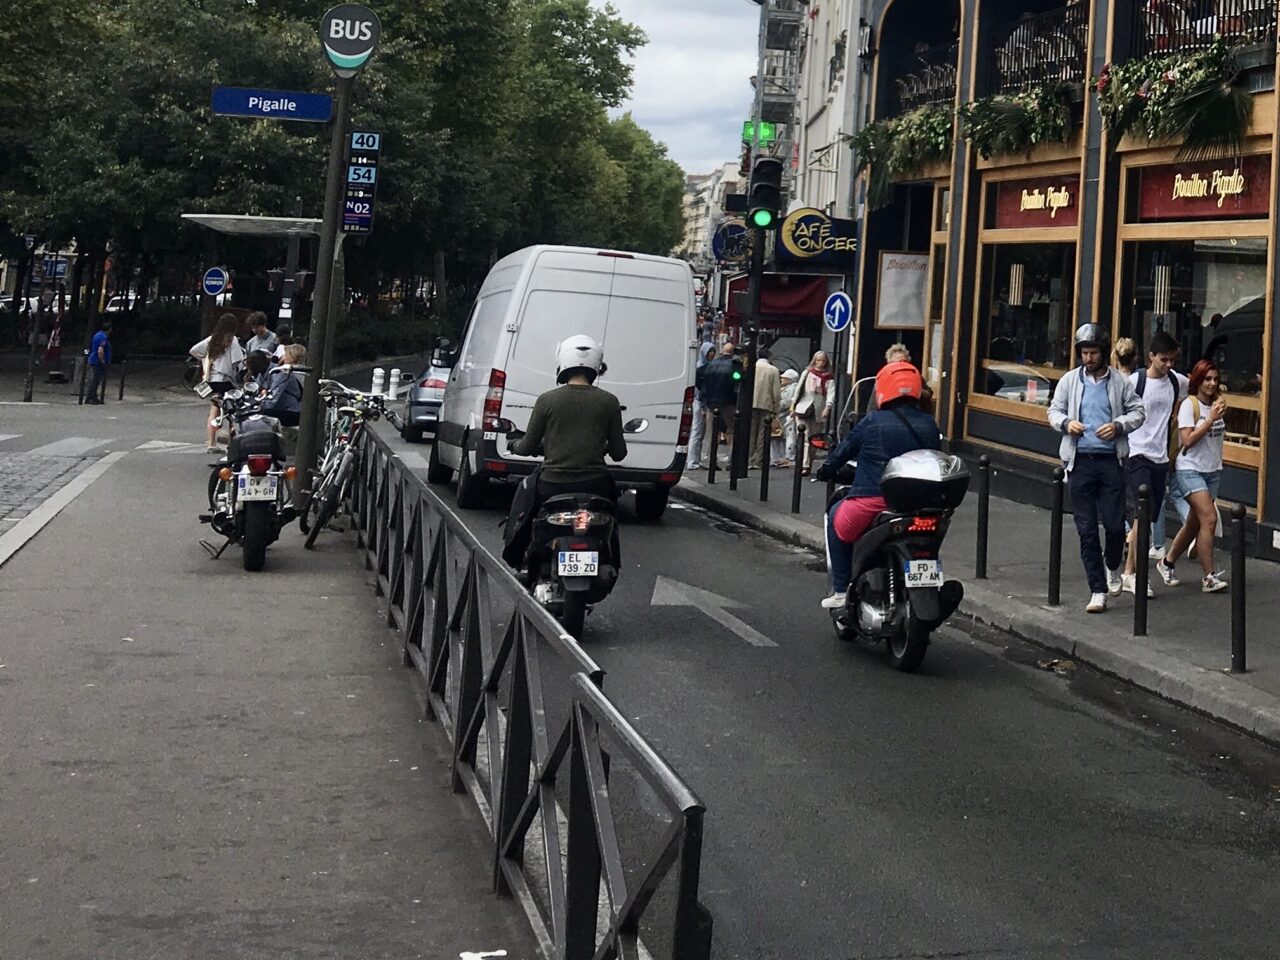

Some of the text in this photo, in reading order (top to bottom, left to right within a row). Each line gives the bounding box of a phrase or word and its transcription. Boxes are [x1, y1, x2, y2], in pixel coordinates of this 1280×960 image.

[329, 18, 373, 41] BUS
[248, 96, 297, 112] Pigalle
[354, 134, 376, 148] 40
[352, 167, 372, 182] 54
[1172, 168, 1244, 208] Bouillon Pigalle
